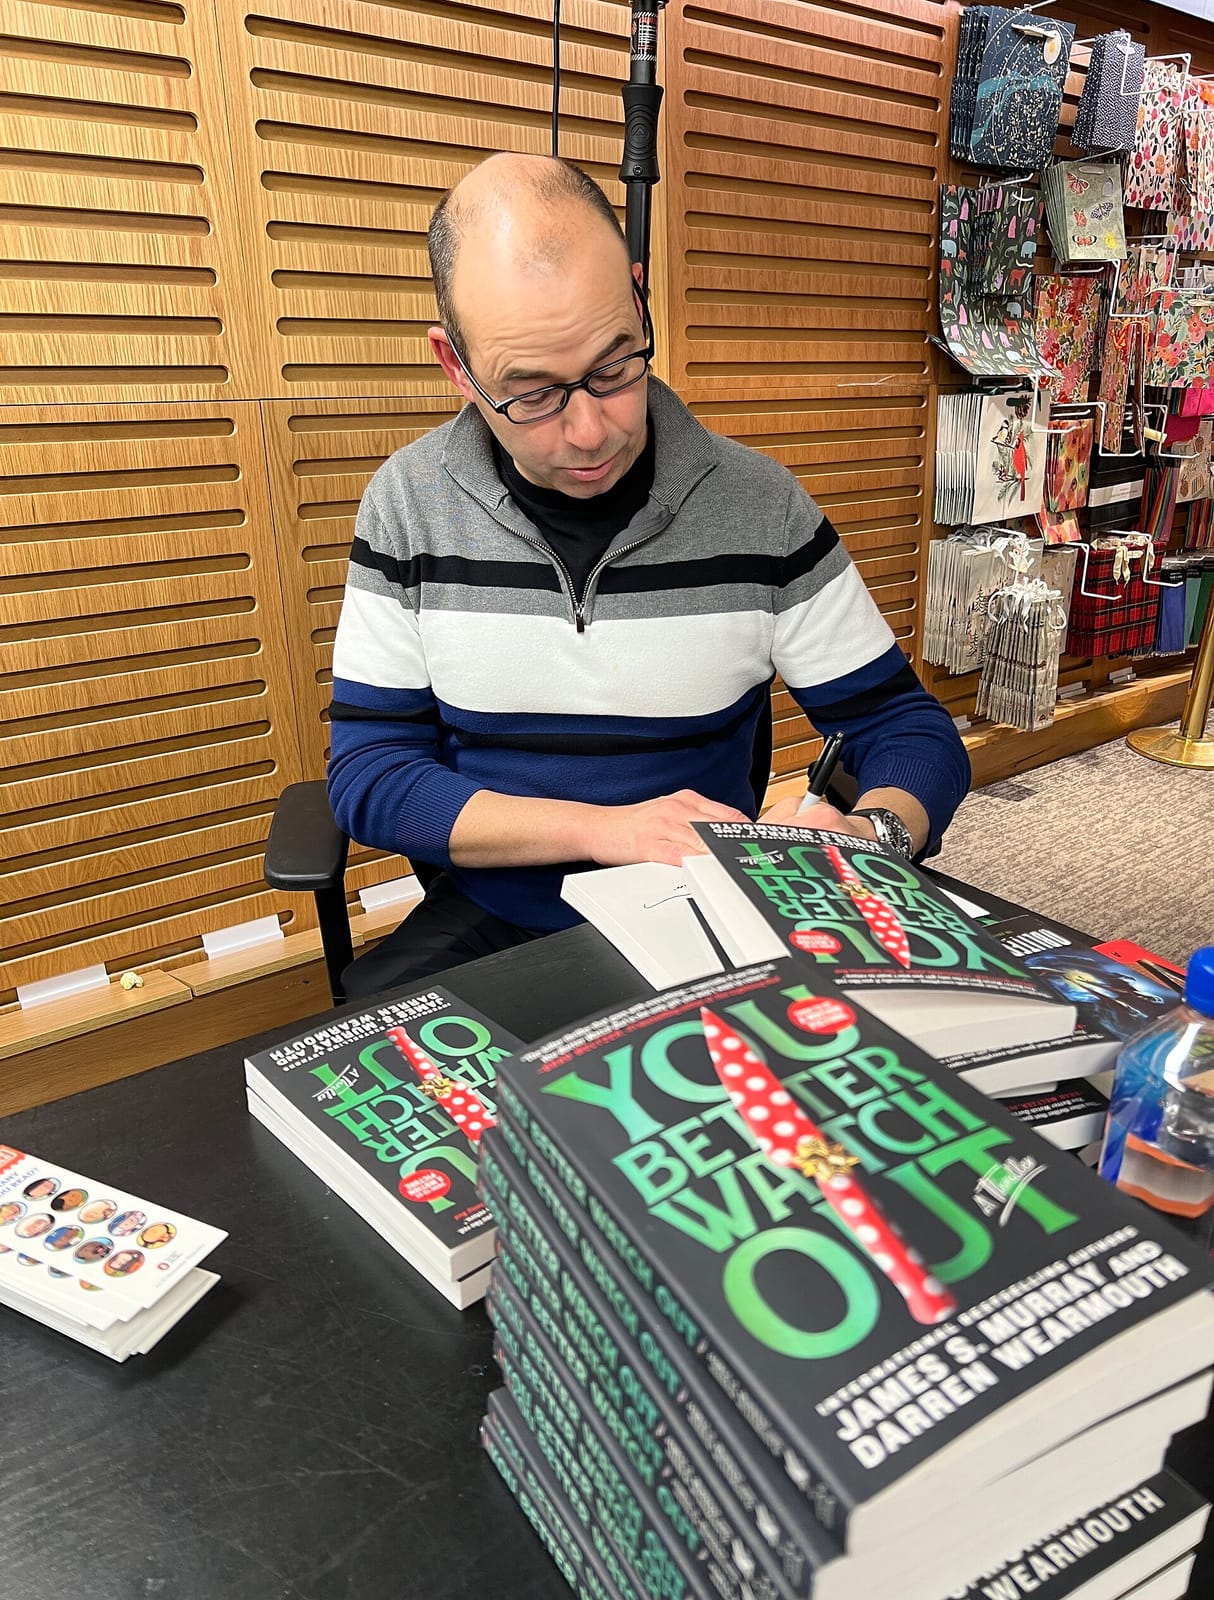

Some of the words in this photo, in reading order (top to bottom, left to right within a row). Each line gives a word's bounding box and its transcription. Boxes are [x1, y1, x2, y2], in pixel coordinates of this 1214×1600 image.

[739, 843, 920, 889] OUT
[750, 876, 956, 915] WATCH
[768, 897, 978, 936] BETTER
[794, 920, 1031, 979] YOU
[376, 1015, 393, 1024] S.
[377, 992, 440, 1017] DARREN
[395, 997, 445, 1020] JAMES
[269, 1014, 376, 1062] WEARMOUTH
[276, 1051, 307, 1066] AND
[308, 1016, 492, 1117] OUT
[311, 1021, 379, 1054] MURRAY
[540, 984, 860, 1144] YOU
[335, 1046, 514, 1141] WATCH
[611, 1046, 926, 1206] BETTER
[648, 1081, 987, 1252] WATCH
[972, 1192, 1000, 1217] A
[723, 1126, 1080, 1359] OUT
[815, 1322, 961, 1417] INTERNATIONAL
[957, 1259, 1070, 1328] BESTSELLING
[1066, 1225, 1139, 1266] AUTHORS
[835, 1352, 951, 1442] JAMES
[944, 1335, 989, 1365] S.
[976, 1261, 1108, 1346] MURRAY
[1106, 1240, 1164, 1276] AND
[847, 1361, 1000, 1470] DARREN
[989, 1253, 1190, 1372] WEARMOUTH
[982, 1486, 1166, 1600] WEARMOUTH
